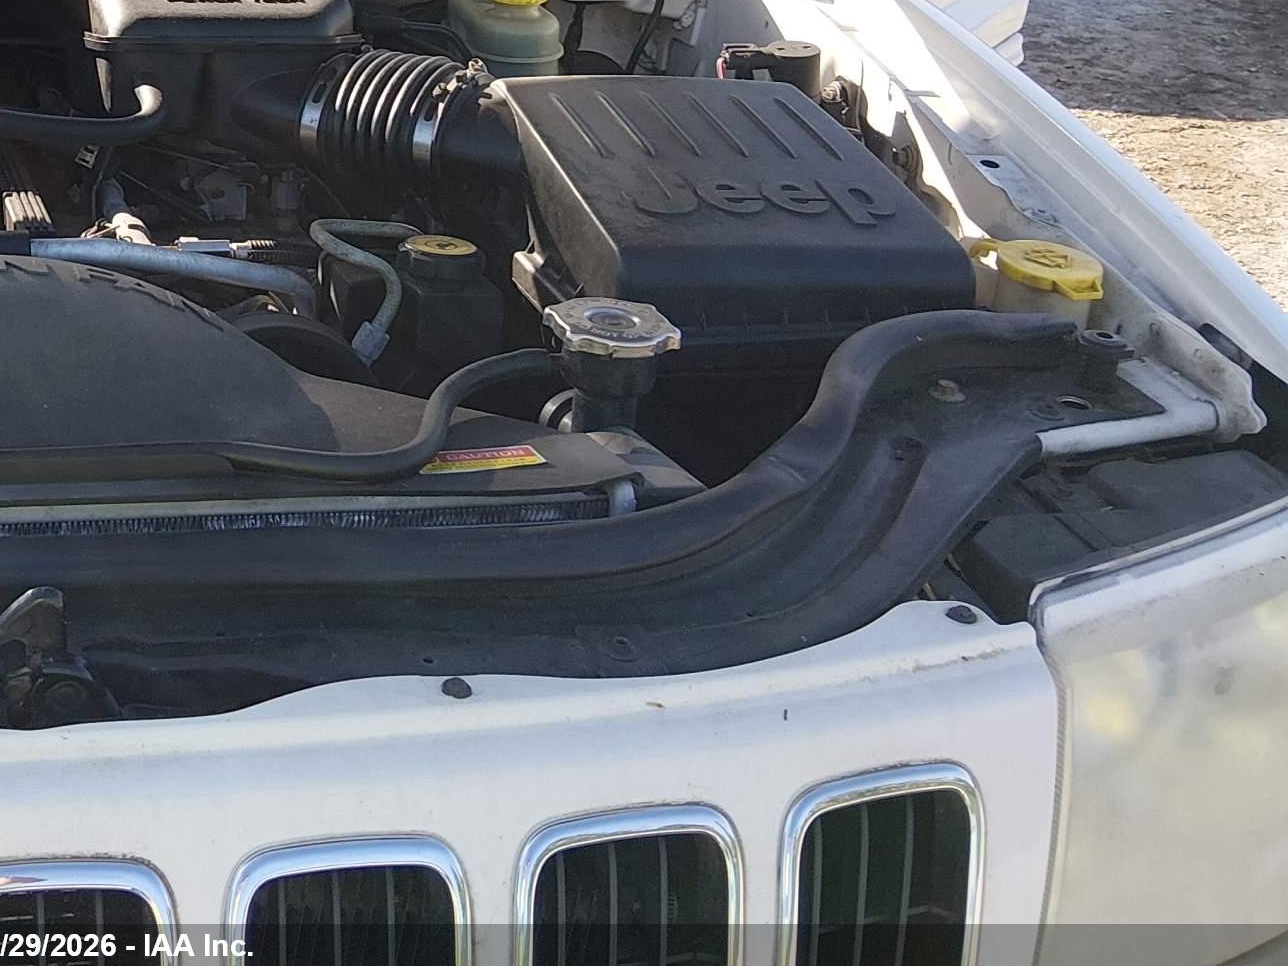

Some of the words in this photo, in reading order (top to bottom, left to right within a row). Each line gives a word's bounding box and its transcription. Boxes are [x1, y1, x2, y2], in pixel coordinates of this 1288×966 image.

[620, 164, 897, 227] Jeep
[73, 264, 232, 333] FAN
[445, 448, 526, 461] CAUTION
